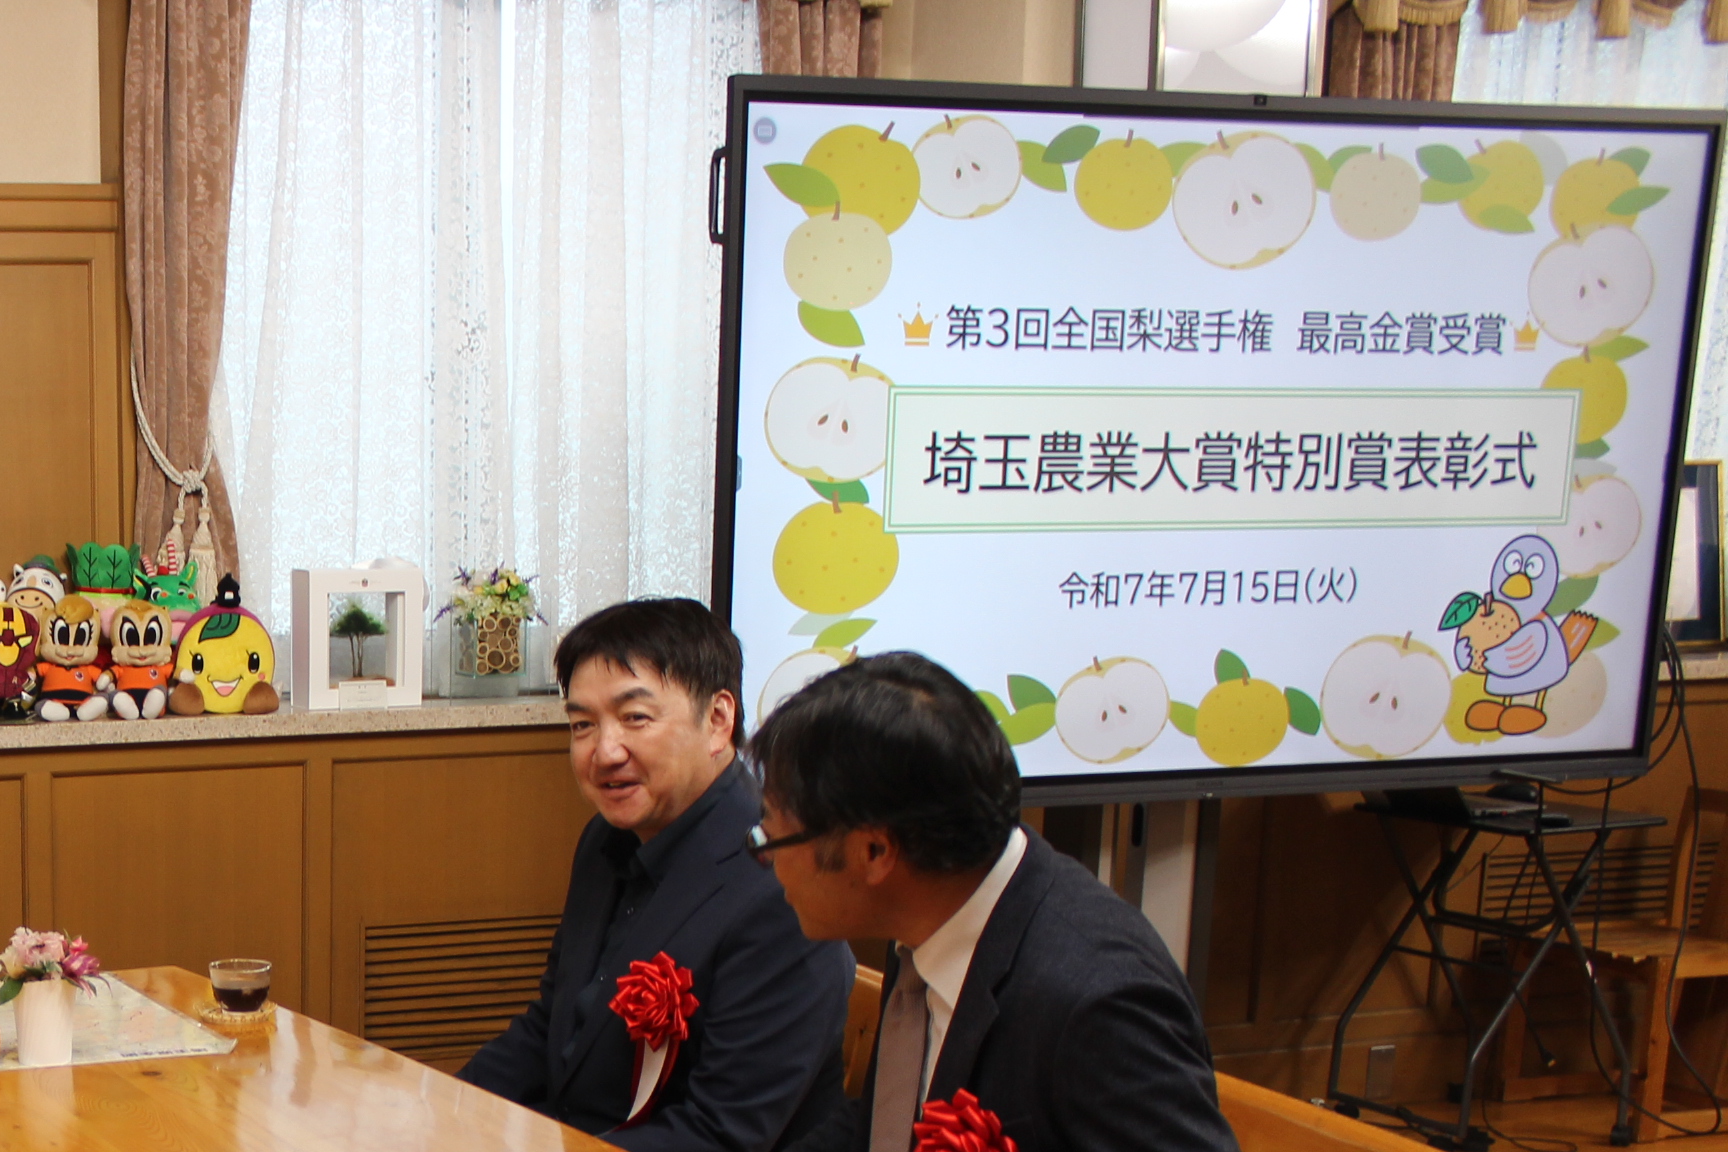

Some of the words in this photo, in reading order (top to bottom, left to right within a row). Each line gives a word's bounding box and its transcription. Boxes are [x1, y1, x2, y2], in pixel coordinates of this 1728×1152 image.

[945, 303, 1273, 354] 第3回全国梨選手権
[1296, 310, 1508, 356] 最高金賞受賞
[922, 431, 1539, 494] 埼玉農業大賞特別賞表彰式
[1058, 566, 1359, 609] 令和7年7月15日(火)
